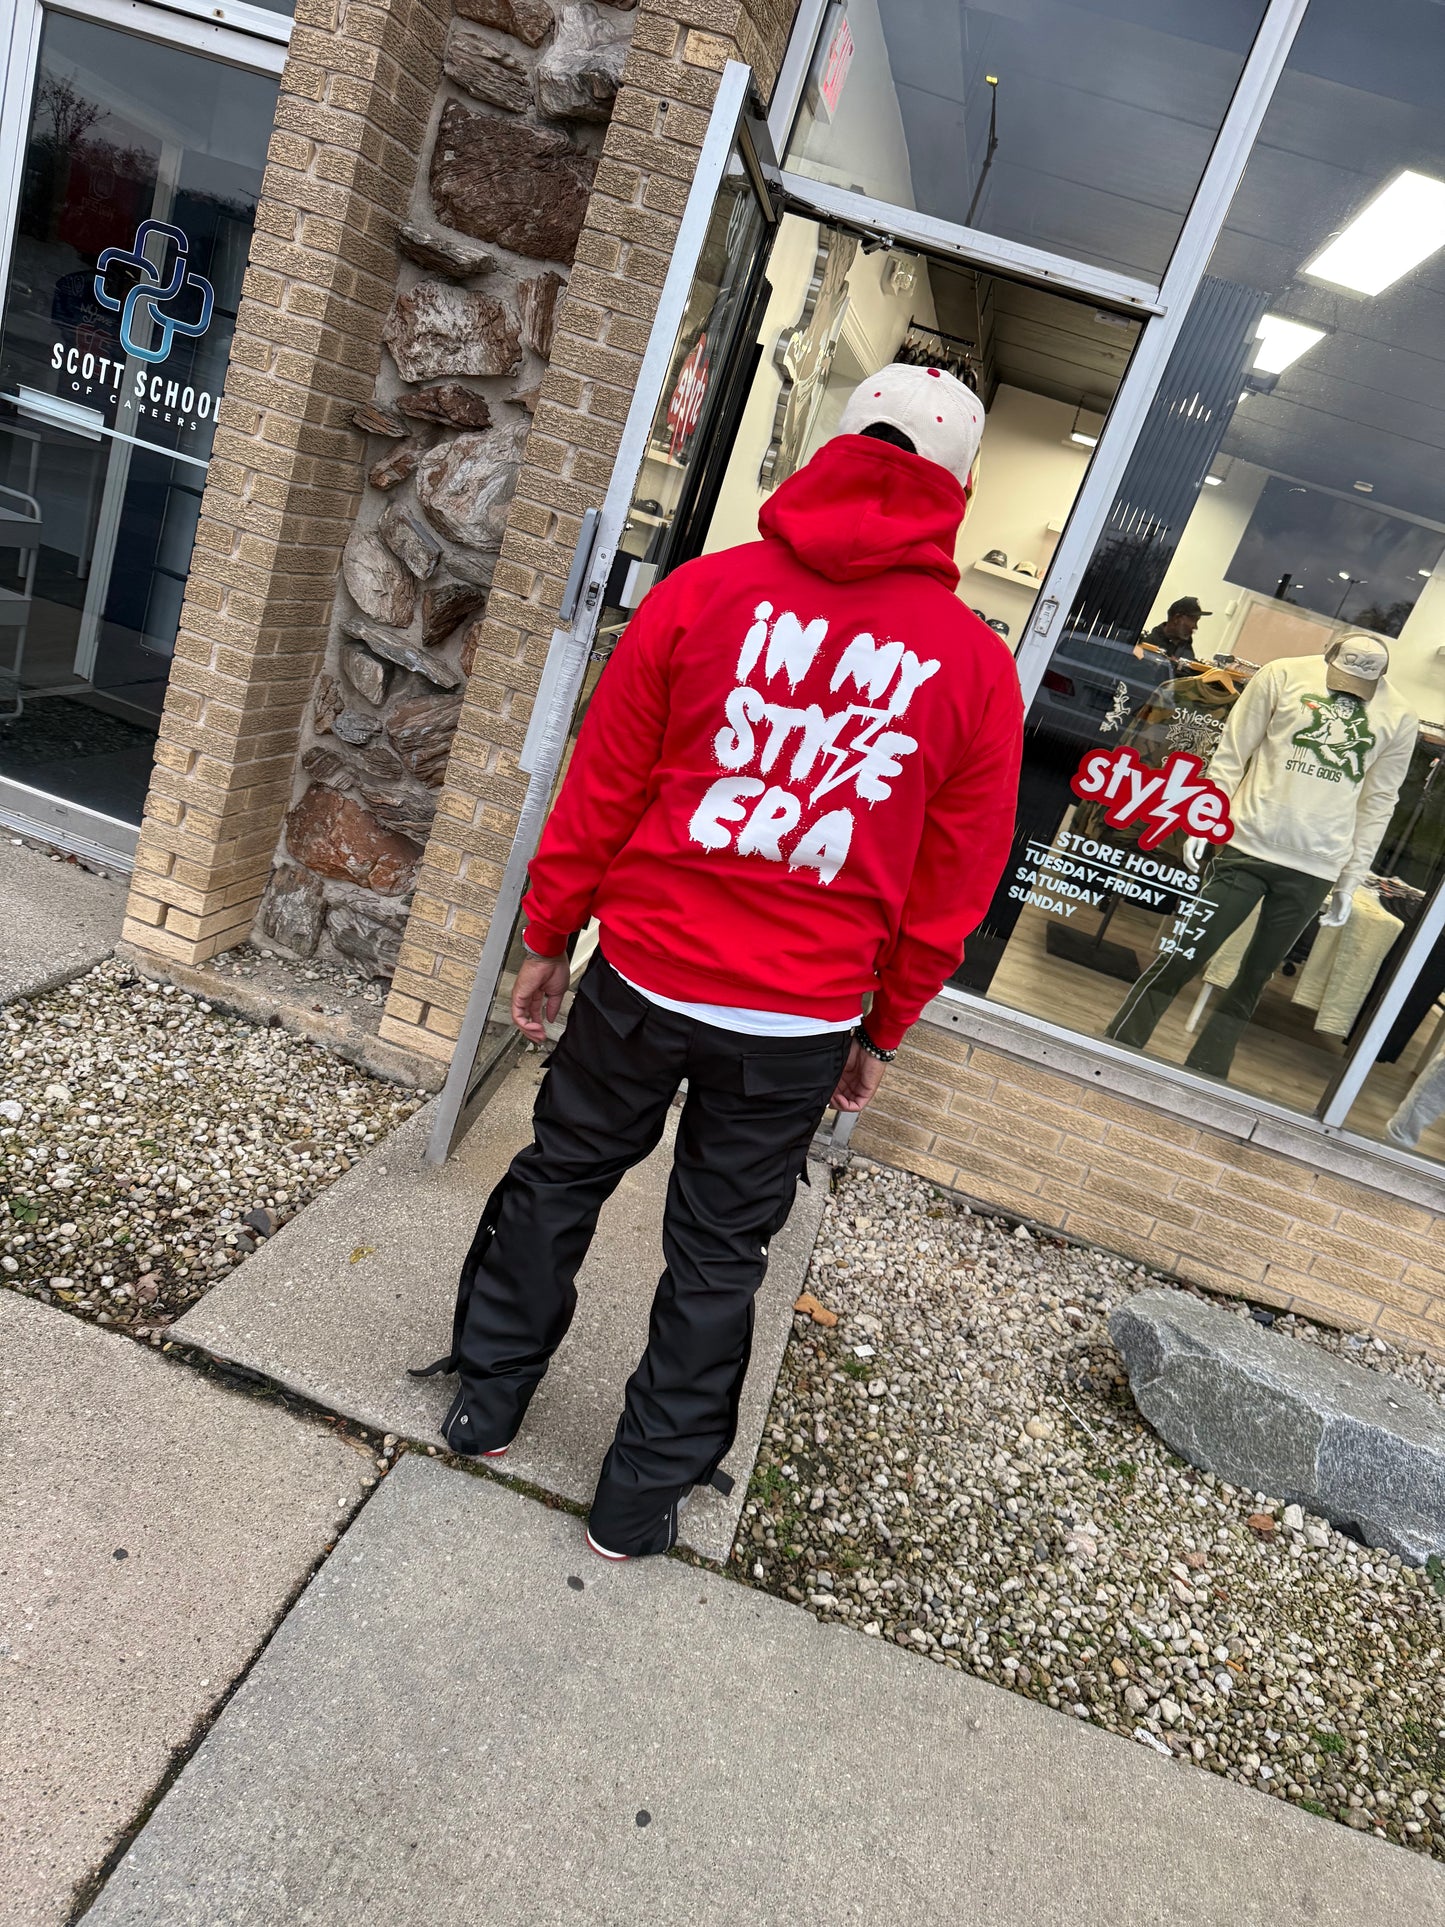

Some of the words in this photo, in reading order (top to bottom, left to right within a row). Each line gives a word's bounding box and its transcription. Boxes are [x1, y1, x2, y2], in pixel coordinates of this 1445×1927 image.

[51, 342, 125, 390] SCOTT
[71, 383, 94, 396] OF
[109, 395, 198, 431] CAREERS
[829, 632, 942, 717] MY
[1286, 760, 1315, 777] STYLE
[1316, 766, 1341, 784] GODS
[688, 775, 856, 886] ERA
[1056, 831, 1123, 867] STORE
[1125, 851, 1201, 892] HOURS
[1015, 867, 1105, 907] SATURDAY
[1172, 920, 1207, 941] 11-7
[1024, 847, 1167, 907] TUESDAY-FRIDAY
[1176, 900, 1215, 923] 12-7
[1008, 885, 1077, 918] SUNDAY
[1158, 937, 1197, 960] 12-4
